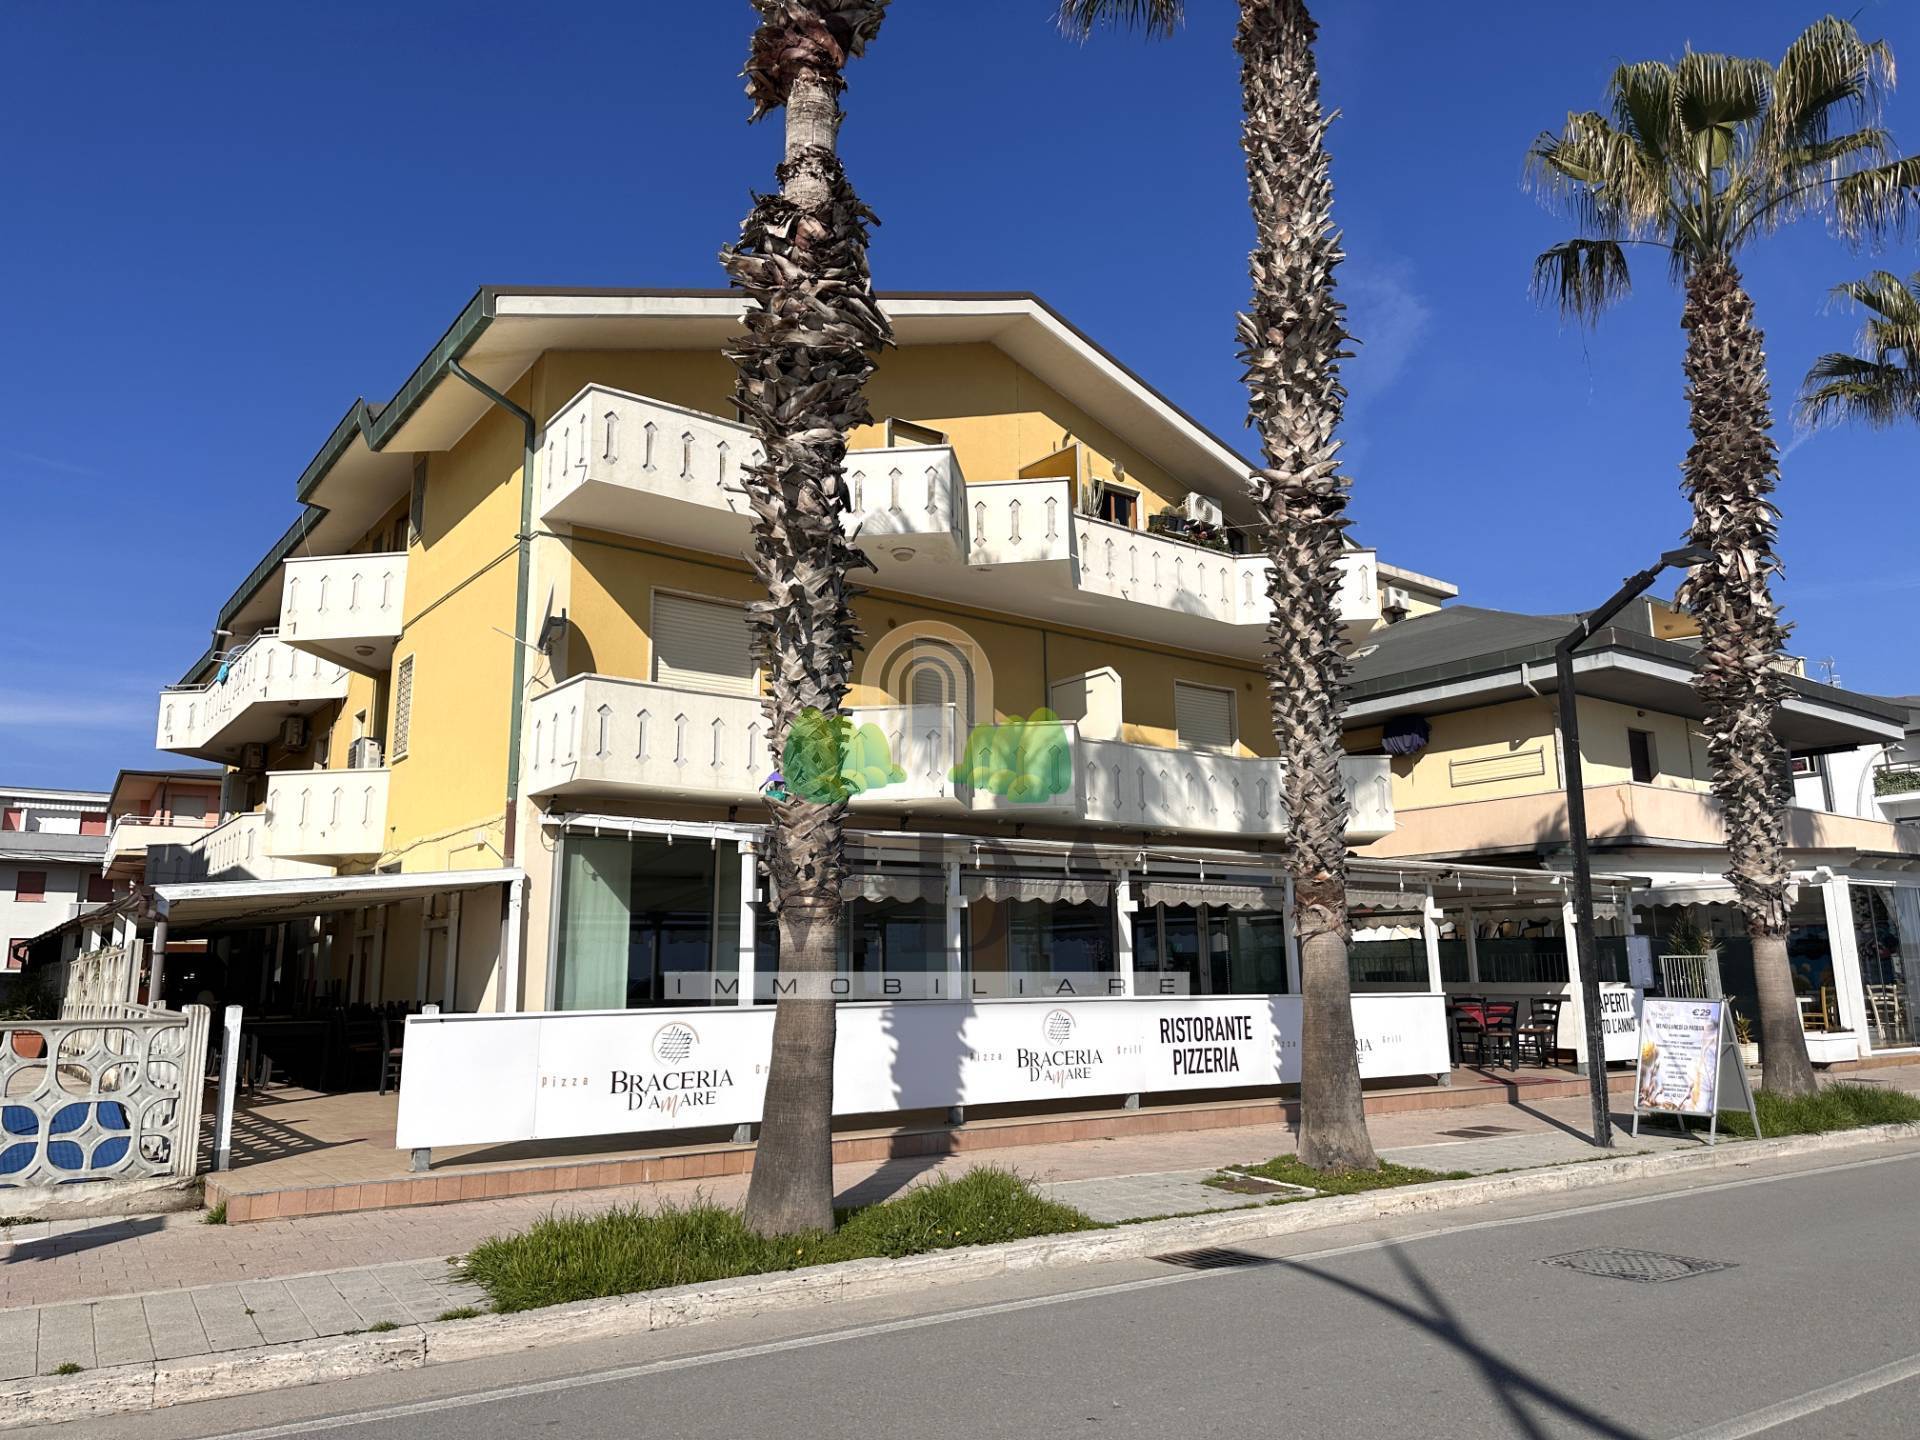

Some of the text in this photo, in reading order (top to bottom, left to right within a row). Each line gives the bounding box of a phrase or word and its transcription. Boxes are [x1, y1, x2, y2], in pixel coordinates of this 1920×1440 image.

[1160, 1015, 1253, 1044] RISTORANTE
[1017, 1048, 1103, 1069] BRACERIA
[1173, 1046, 1240, 1075] PIZZERIA
[610, 1069, 734, 1095] BRACERIA
